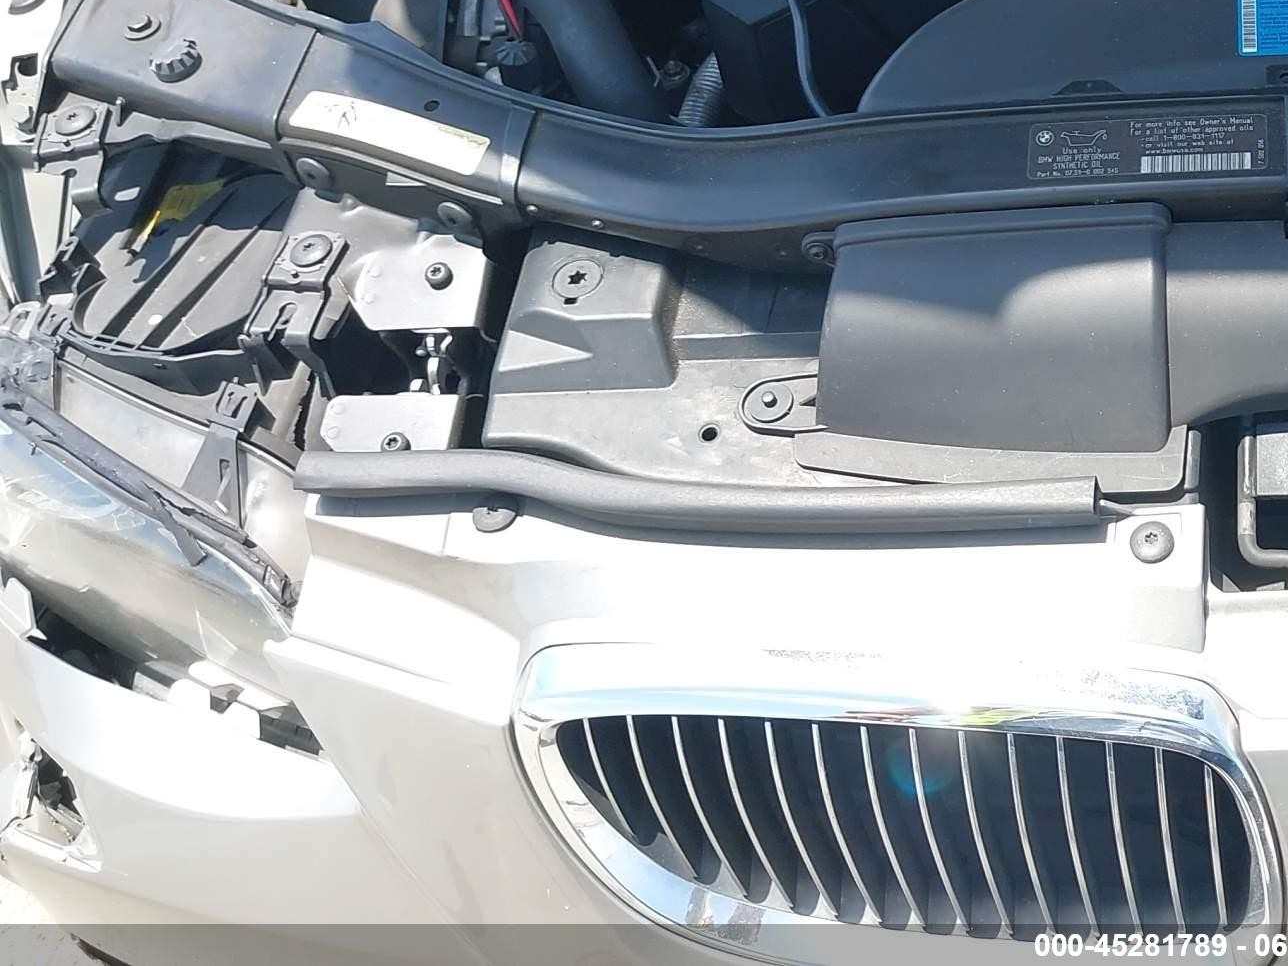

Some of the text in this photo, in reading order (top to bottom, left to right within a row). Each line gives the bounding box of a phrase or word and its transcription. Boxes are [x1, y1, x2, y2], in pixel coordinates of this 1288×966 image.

[1130, 120, 1142, 129] For
[1166, 119, 1181, 127] info
[1200, 117, 1226, 125] Owner's
[1230, 116, 1253, 124] Manual
[1130, 128, 1142, 136] For
[1154, 126, 1167, 135] list
[1170, 126, 1179, 134] of
[1182, 125, 1201, 133] other
[1204, 124, 1236, 133] approved
[1062, 145, 1102, 155] Use only
[1038, 151, 1121, 164] BMW HIGH PERFORMANCE
[1053, 160, 1103, 170] SYNTHETIC OIL
